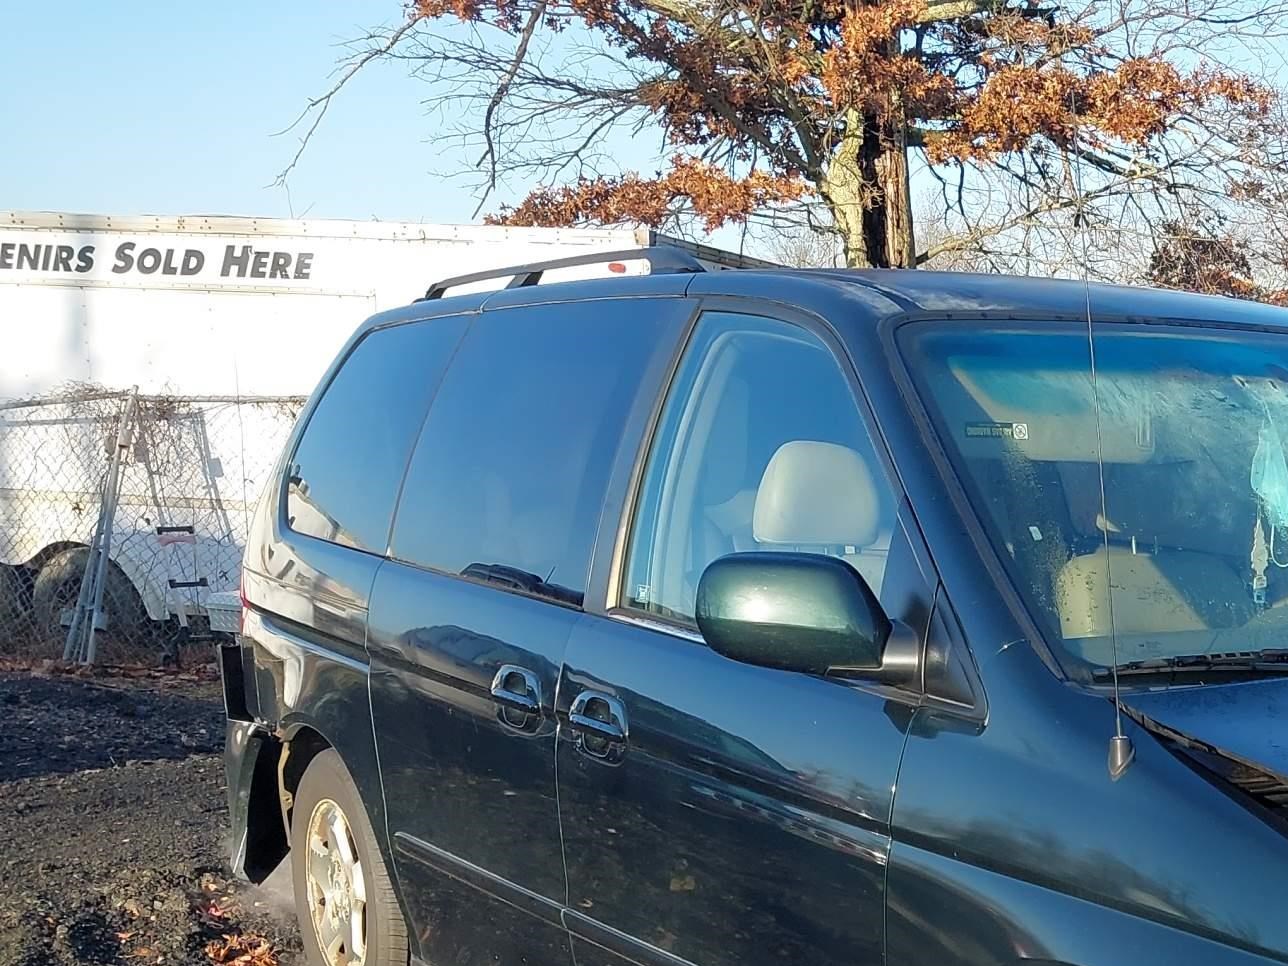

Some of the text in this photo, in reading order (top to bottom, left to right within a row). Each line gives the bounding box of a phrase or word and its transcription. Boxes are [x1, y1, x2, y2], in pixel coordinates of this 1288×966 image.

[0, 241, 314, 280] ENIRS SOLD HERE
